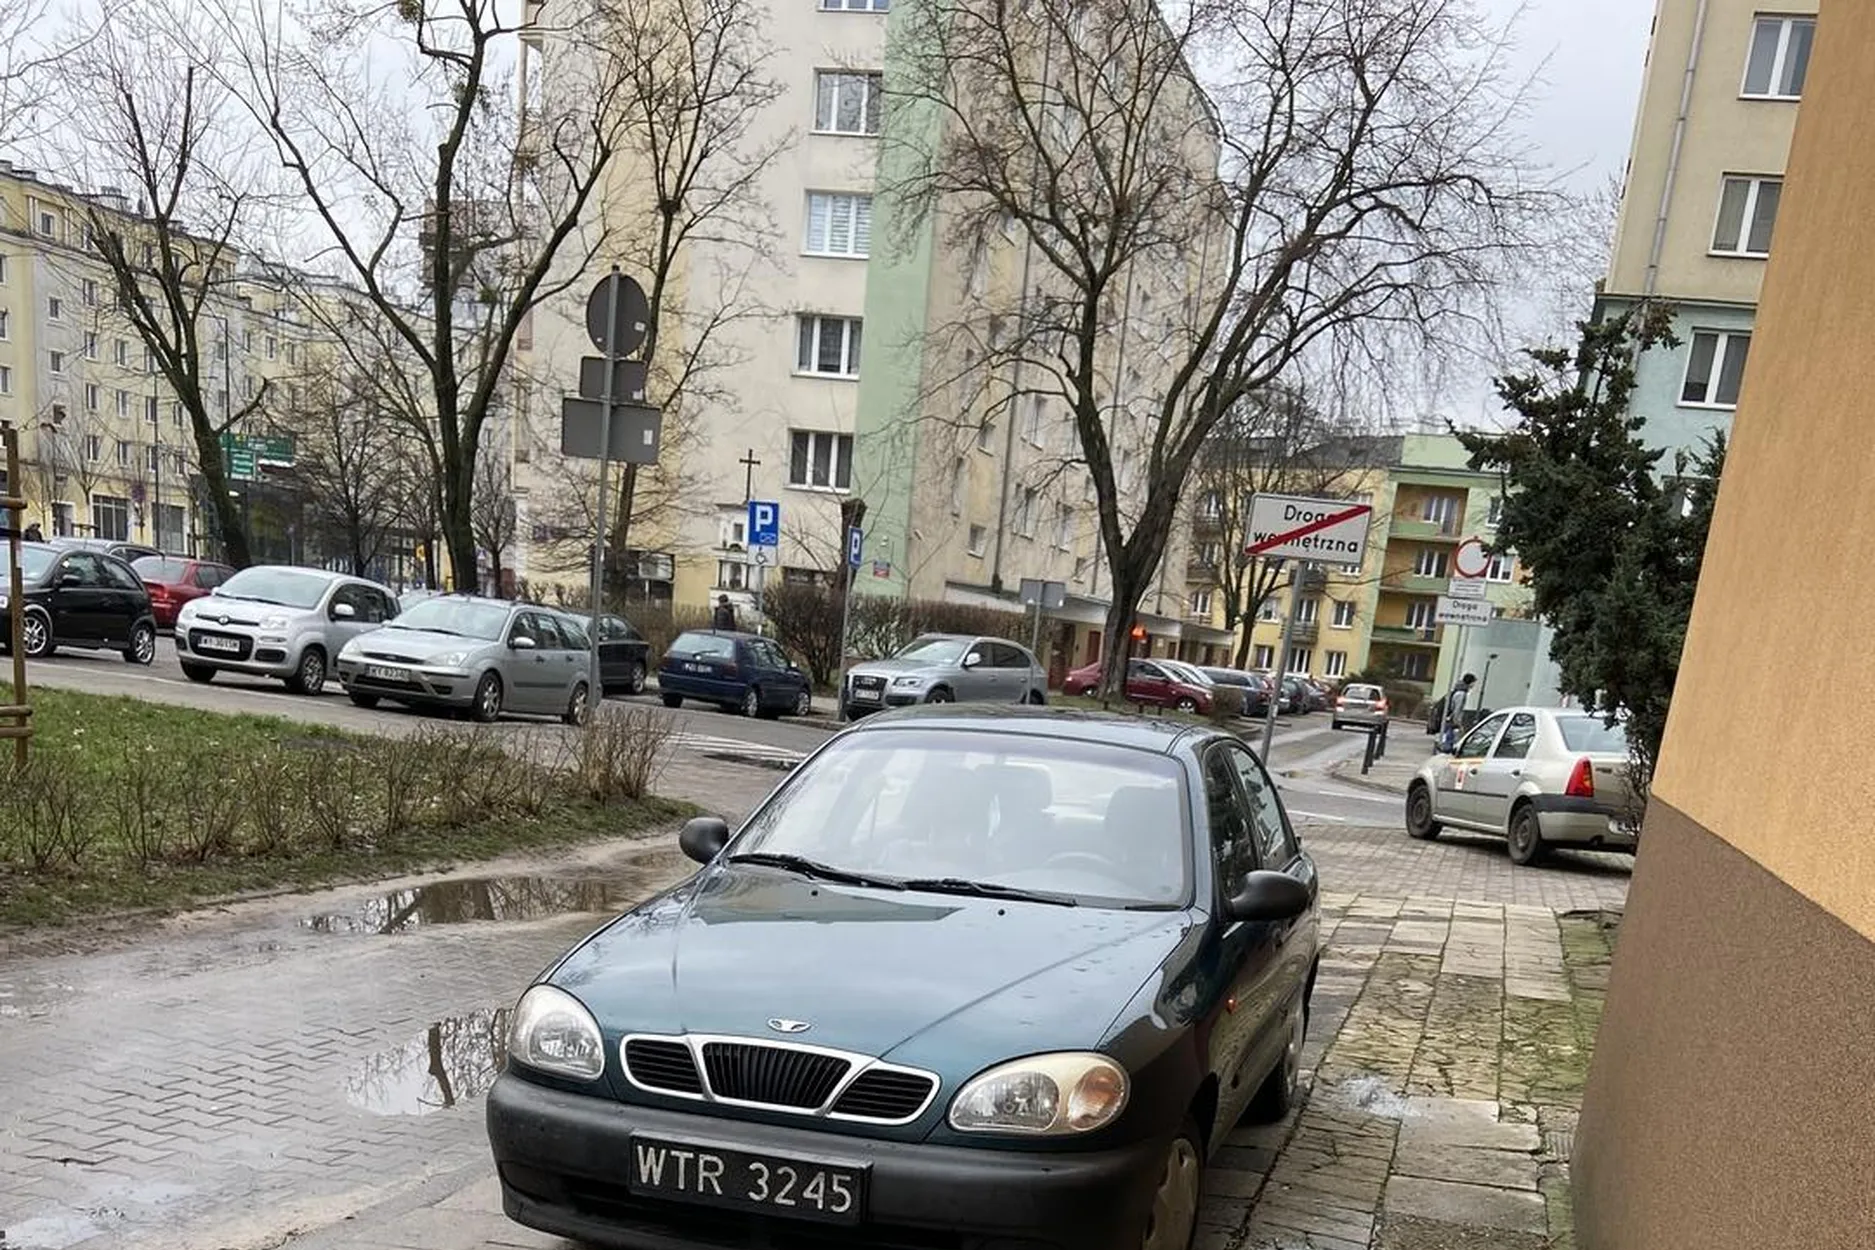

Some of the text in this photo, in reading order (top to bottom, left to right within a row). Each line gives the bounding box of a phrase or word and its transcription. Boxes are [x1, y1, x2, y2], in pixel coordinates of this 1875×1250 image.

[755, 504, 774, 533] P
[850, 531, 861, 564] P
[636, 1144, 852, 1213] WTR 3245
